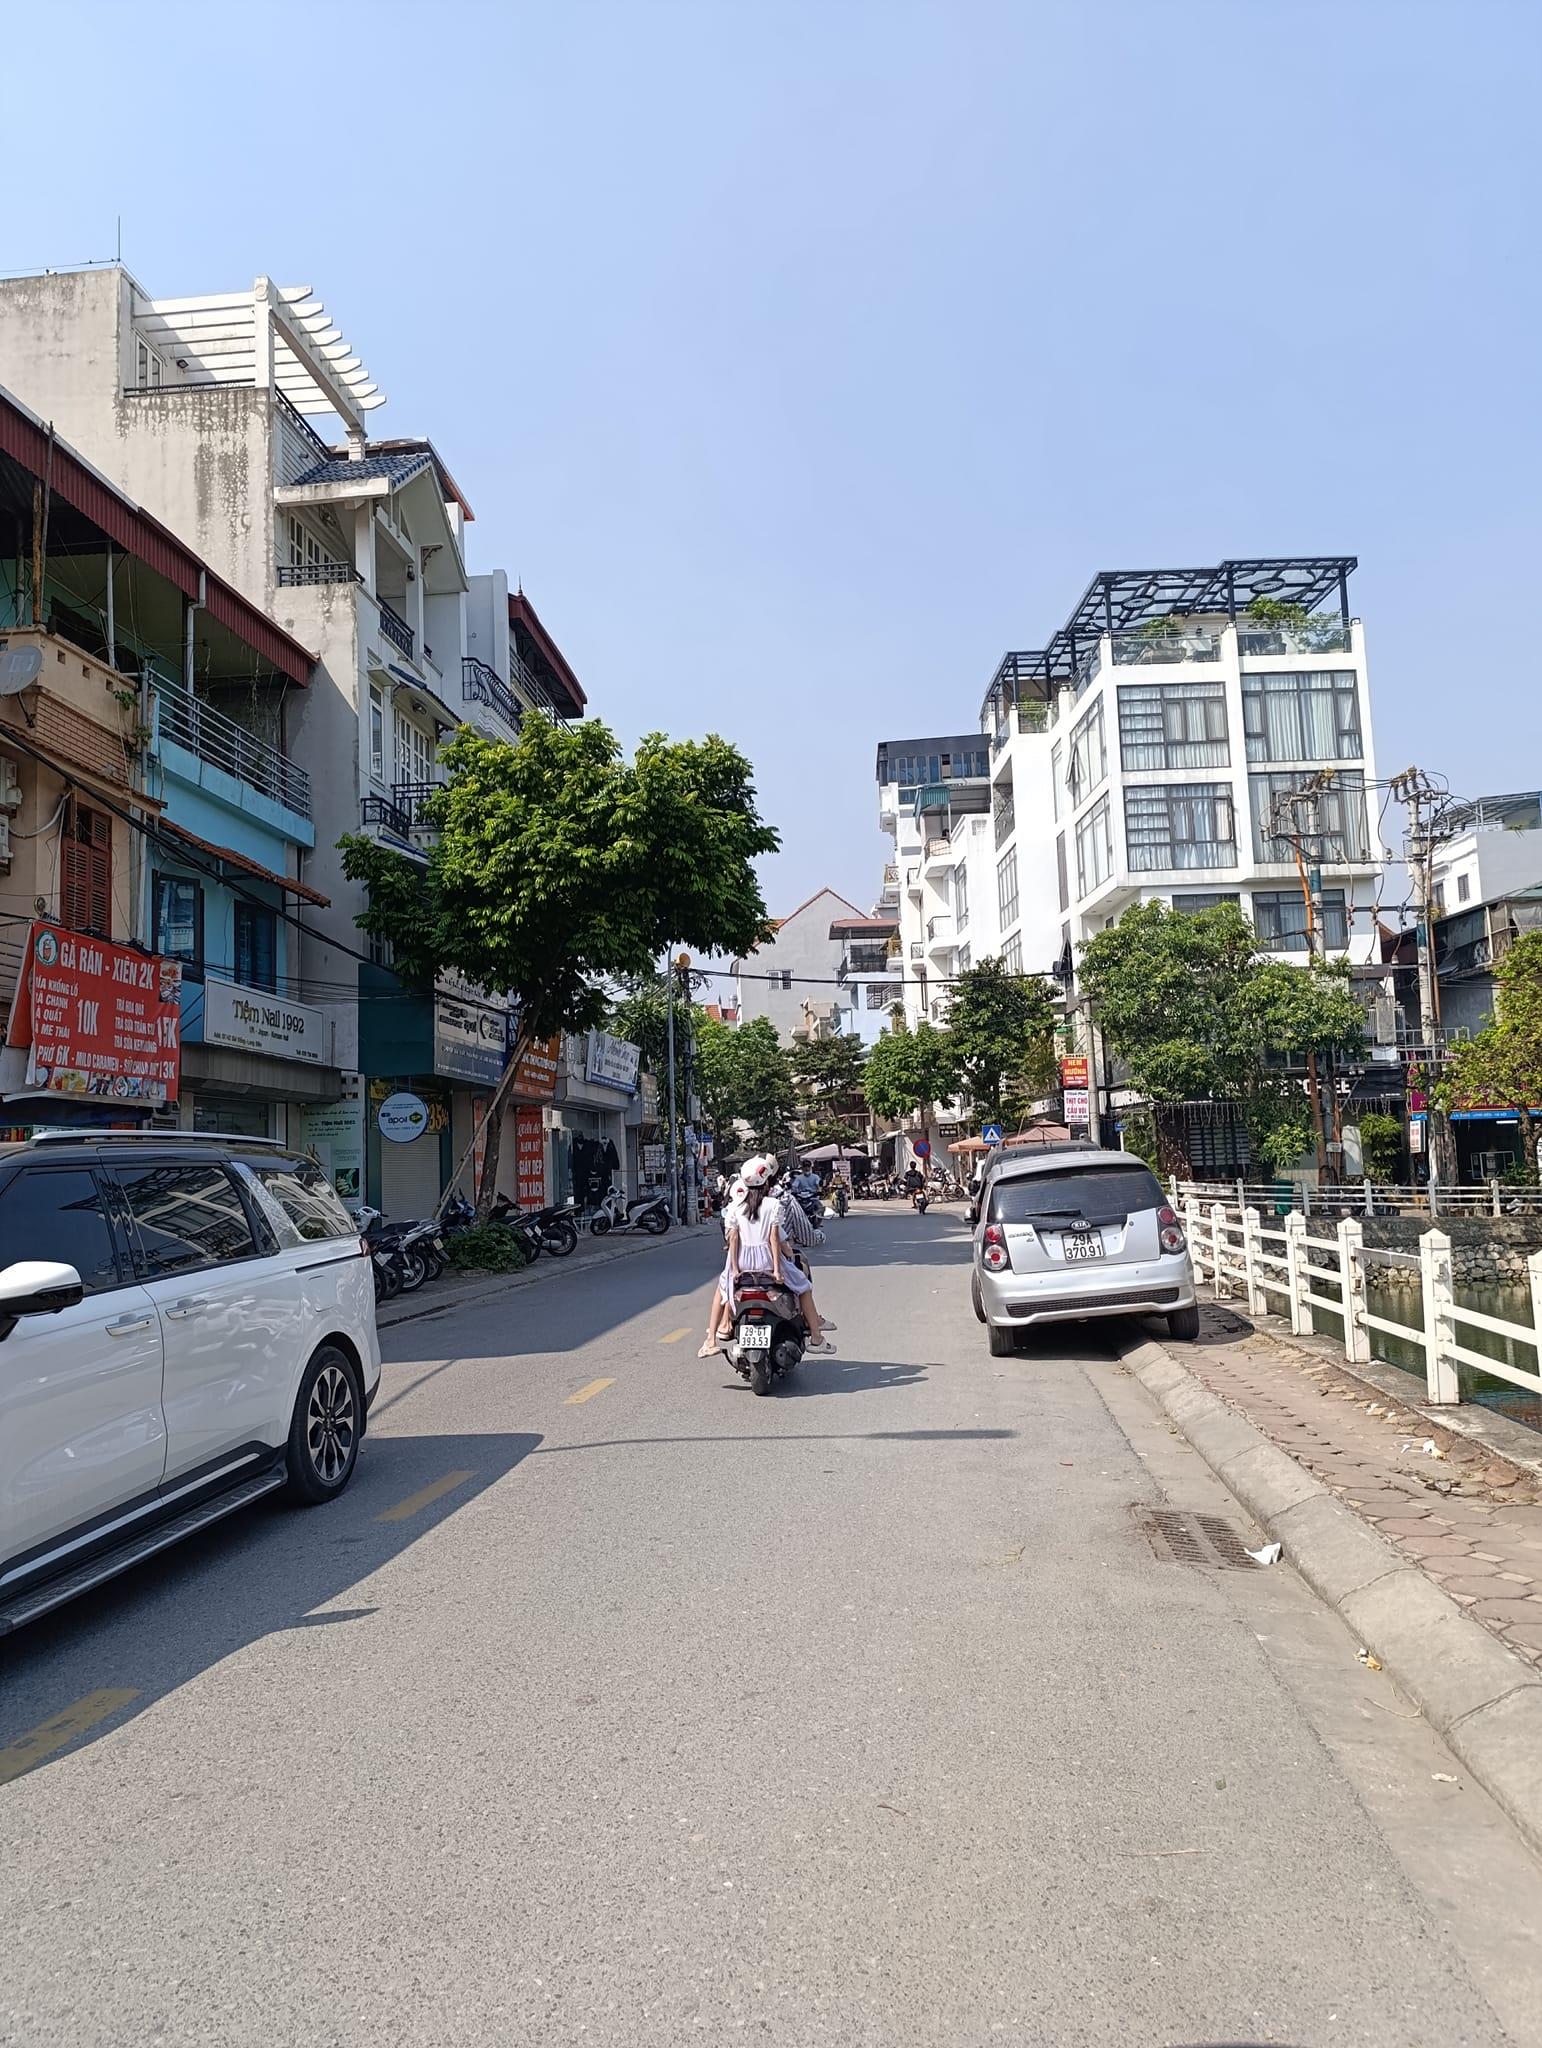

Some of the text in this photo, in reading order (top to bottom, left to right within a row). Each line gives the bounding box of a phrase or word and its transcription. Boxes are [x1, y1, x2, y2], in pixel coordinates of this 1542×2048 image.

[61, 939, 75, 969] GÀ
[80, 944, 103, 976] RÁN
[112, 956, 137, 986] XIÊN
[139, 962, 155, 990] 2K
[77, 999, 99, 1036] 10K
[232, 1000, 305, 1034] Tiệm Nail 1992
[55, 1045, 70, 1066] 6K
[1073, 1234, 1093, 1246] 29A
[1066, 1244, 1102, 1259] 370.91
[741, 1337, 768, 1347] 393.53
